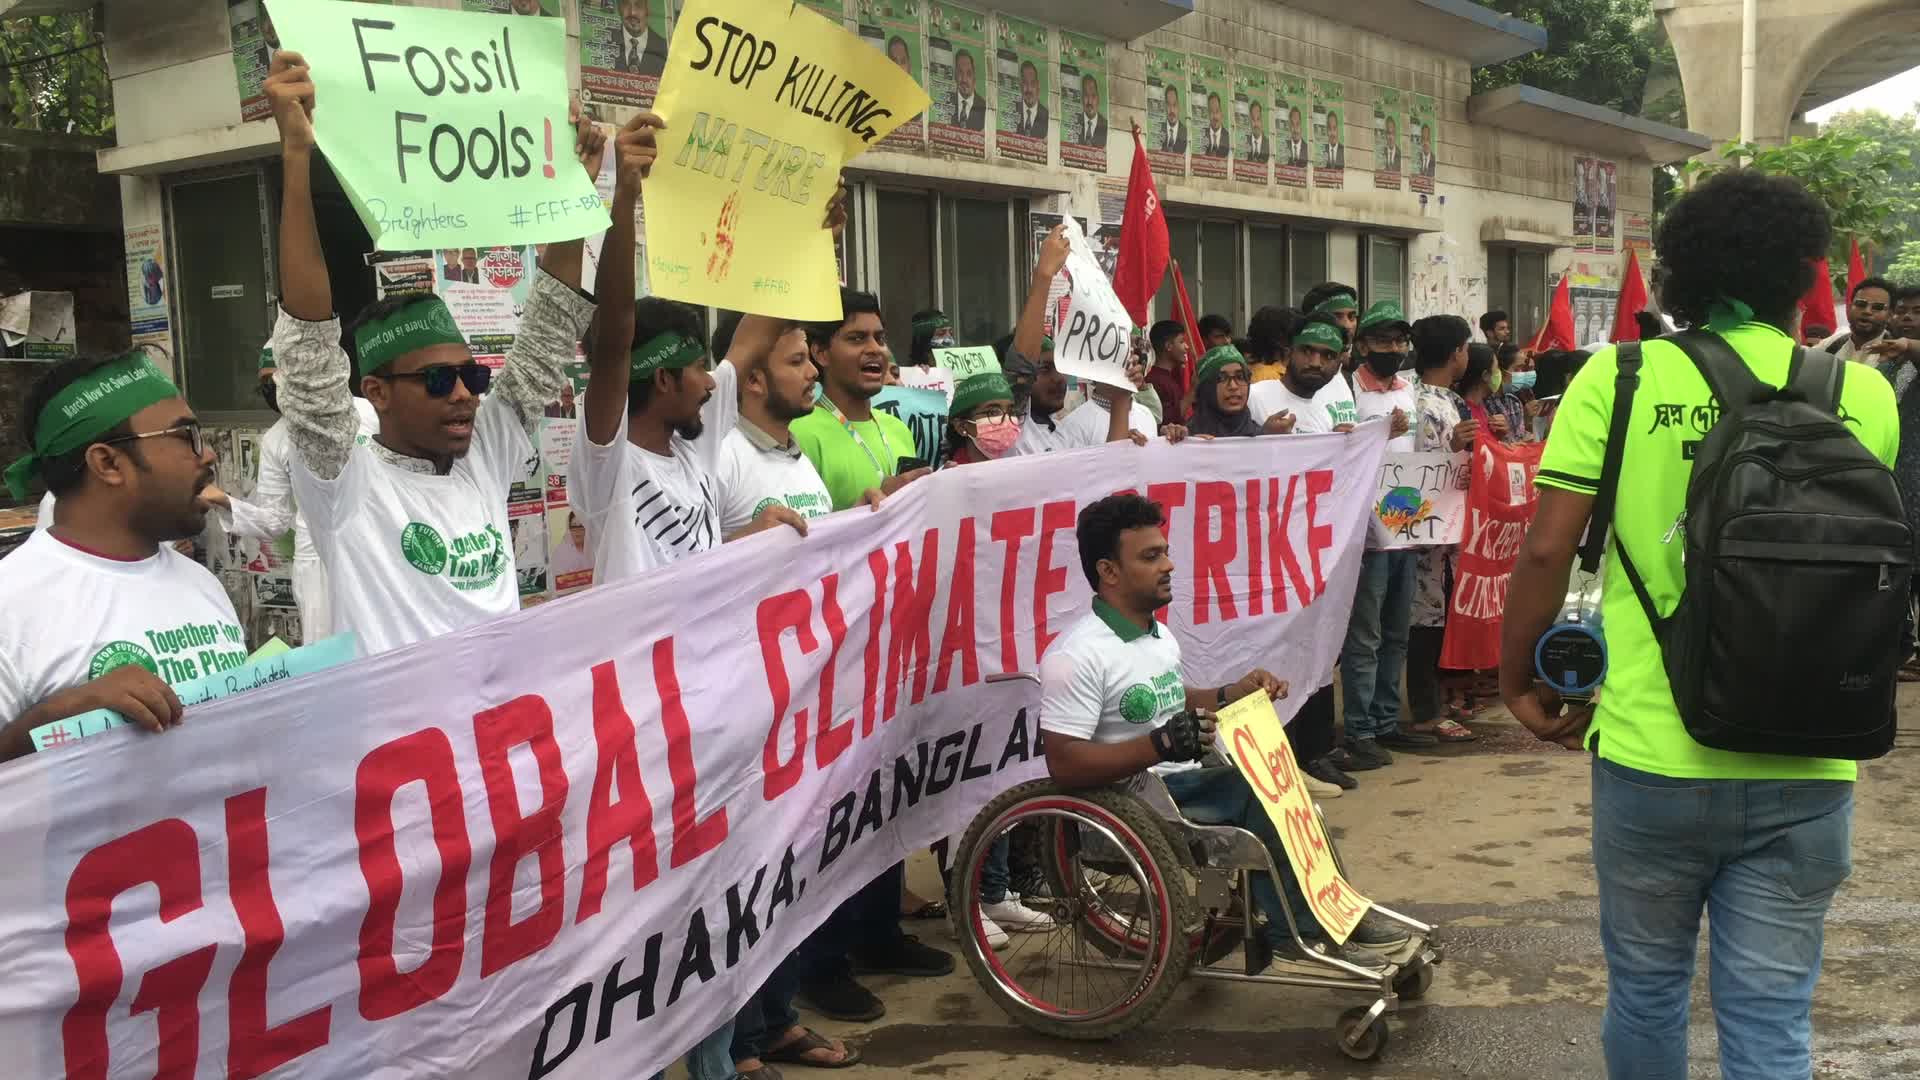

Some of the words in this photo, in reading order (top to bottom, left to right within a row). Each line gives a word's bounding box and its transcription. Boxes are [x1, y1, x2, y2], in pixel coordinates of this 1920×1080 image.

[351, 18, 521, 96] Fossil
[690, 15, 777, 85] STOP
[775, 55, 893, 143] KILLING
[673, 112, 825, 206] NATURE
[61, 396, 88, 420] March
[83, 385, 104, 403] Now
[100, 380, 114, 394] Or
[109, 373, 134, 390] Swim
[1112, 468, 1333, 625] TRIKE
[1394, 515, 1446, 541] ACT
[145, 622, 219, 656] Together
[157, 656, 195, 686] The
[200, 649, 249, 677] Plane
[755, 500, 1077, 801] CLIMATE
[62, 636, 729, 1080] GLOBAL
[528, 843, 808, 1080] DHAKA,
[818, 706, 1048, 873] BANGLA
